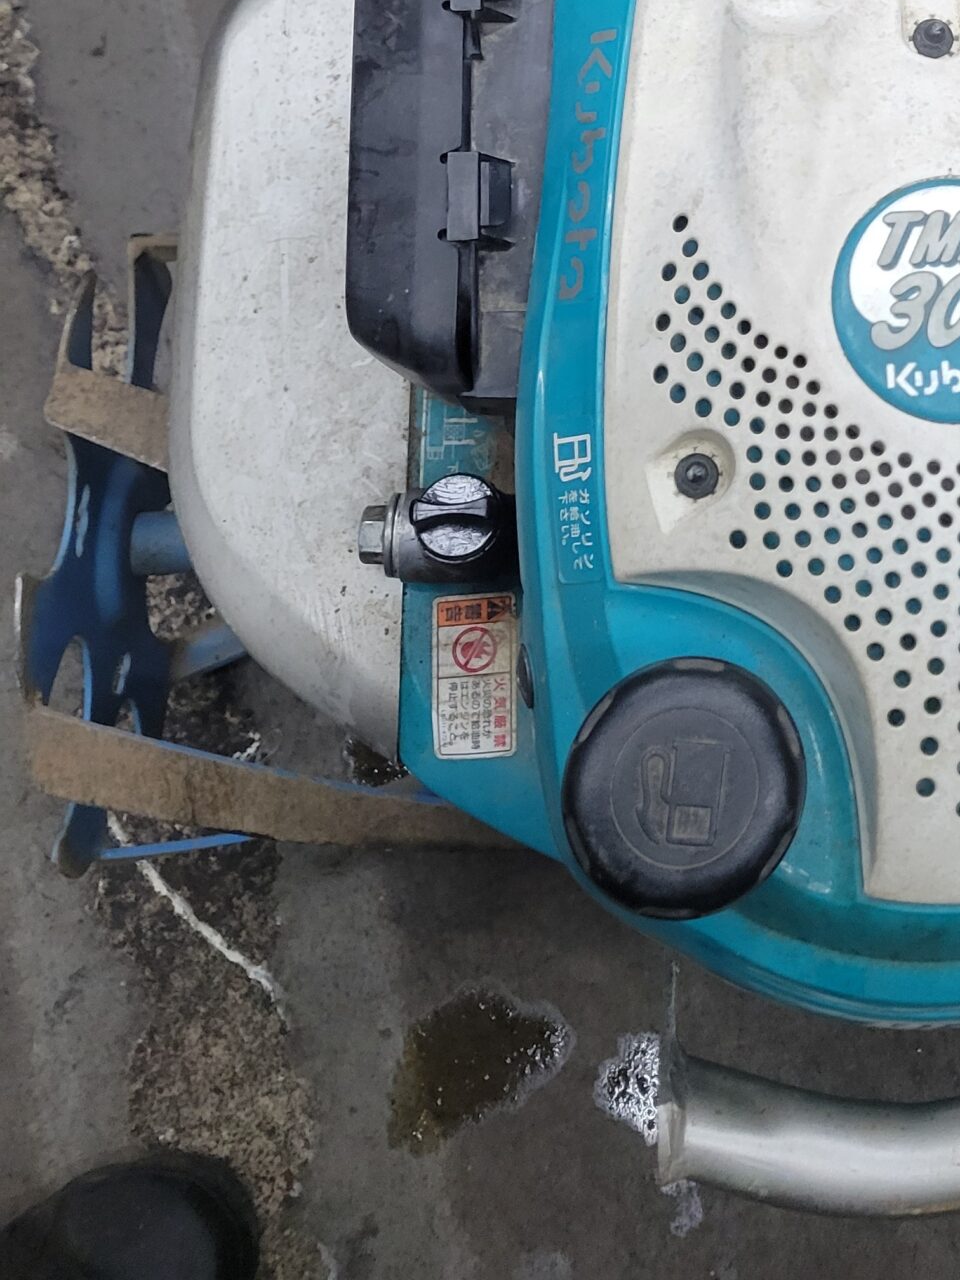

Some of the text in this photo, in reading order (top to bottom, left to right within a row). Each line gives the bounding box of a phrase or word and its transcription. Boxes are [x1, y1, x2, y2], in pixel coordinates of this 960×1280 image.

[553, 27, 619, 304] Kubota
[578, 488, 594, 569] ガソリン
[444, 602, 483, 623] 警告
[493, 677, 507, 748] 火気厳禁
